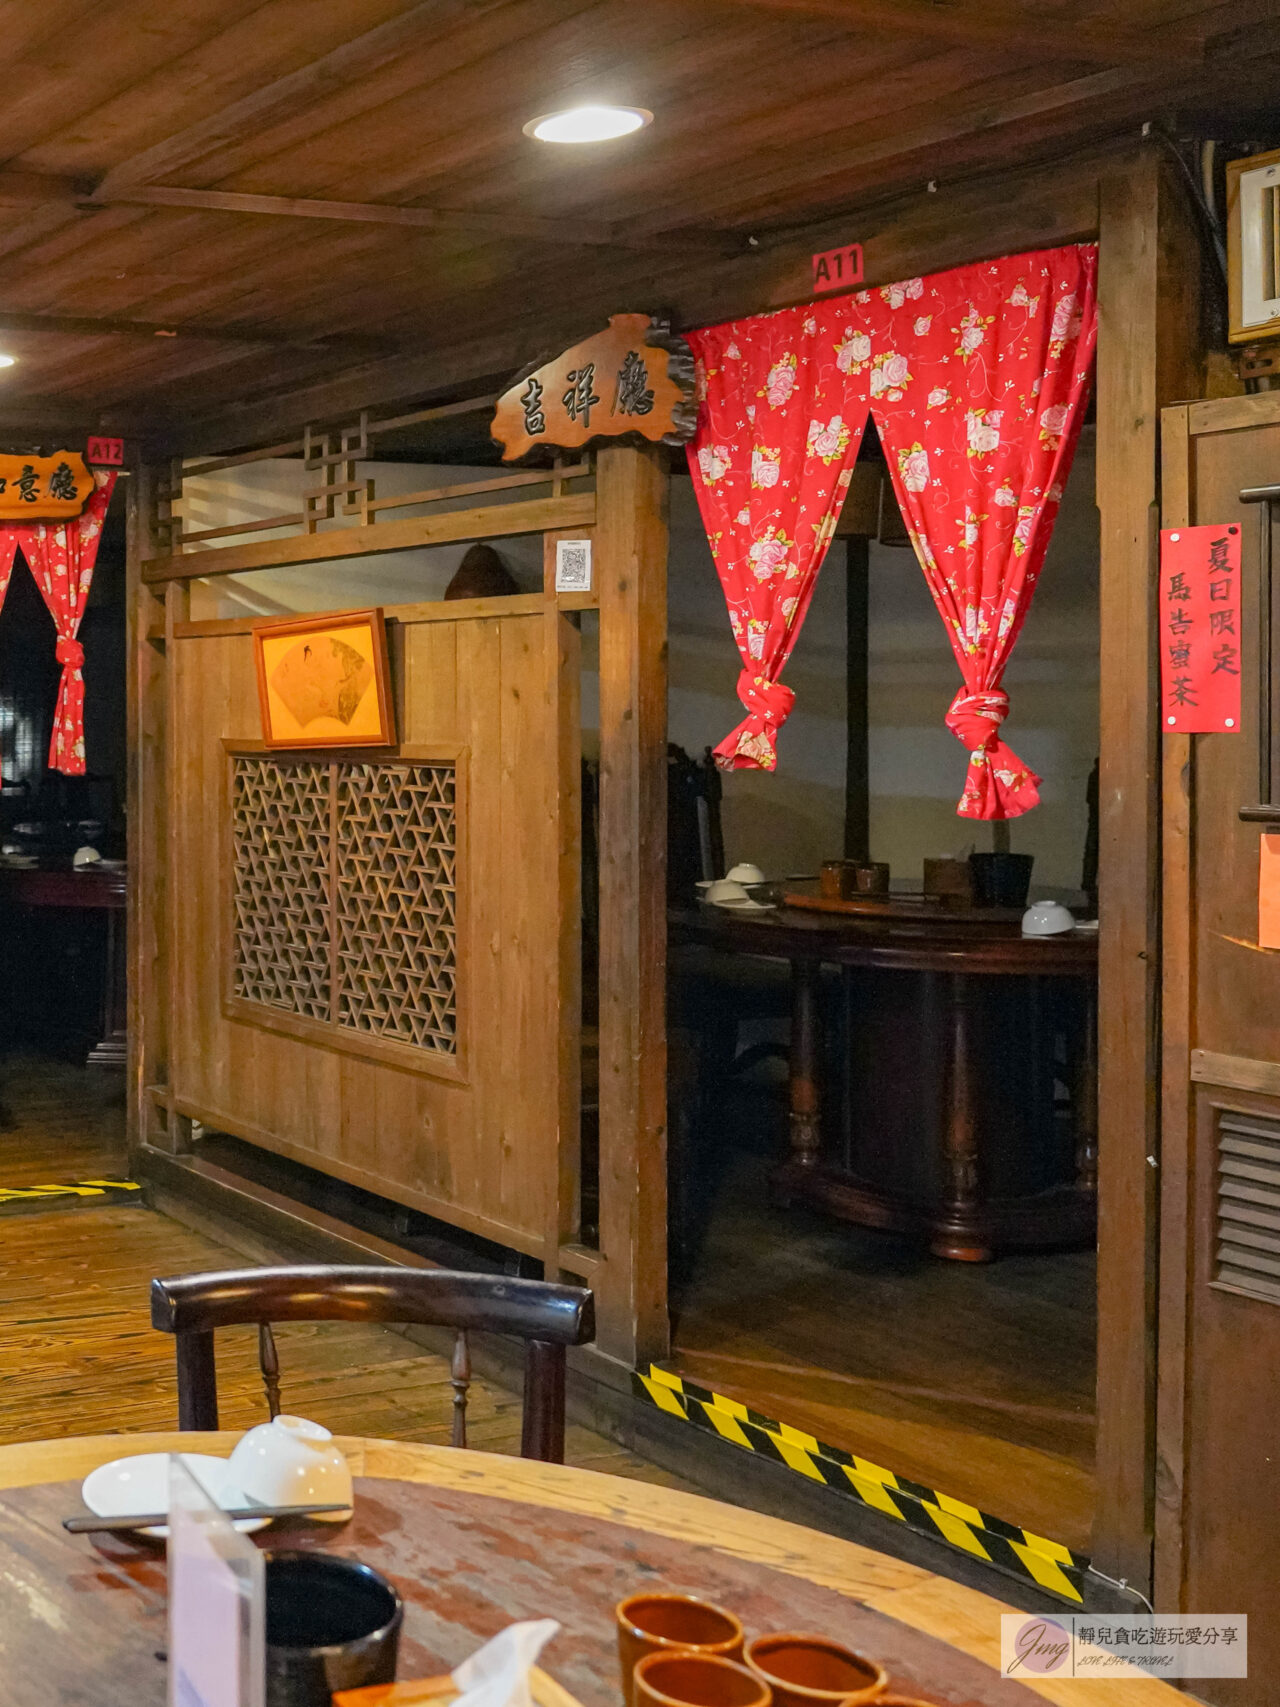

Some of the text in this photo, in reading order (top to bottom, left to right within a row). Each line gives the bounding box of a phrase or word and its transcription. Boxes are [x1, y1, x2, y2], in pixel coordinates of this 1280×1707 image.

[816, 249, 857, 282] A11
[521, 351, 655, 435] 吉祥廳
[92, 443, 122, 459] A12
[1167, 572, 1199, 708] 馬告蜜茶
[1208, 537, 1240, 675] 夏日限定
